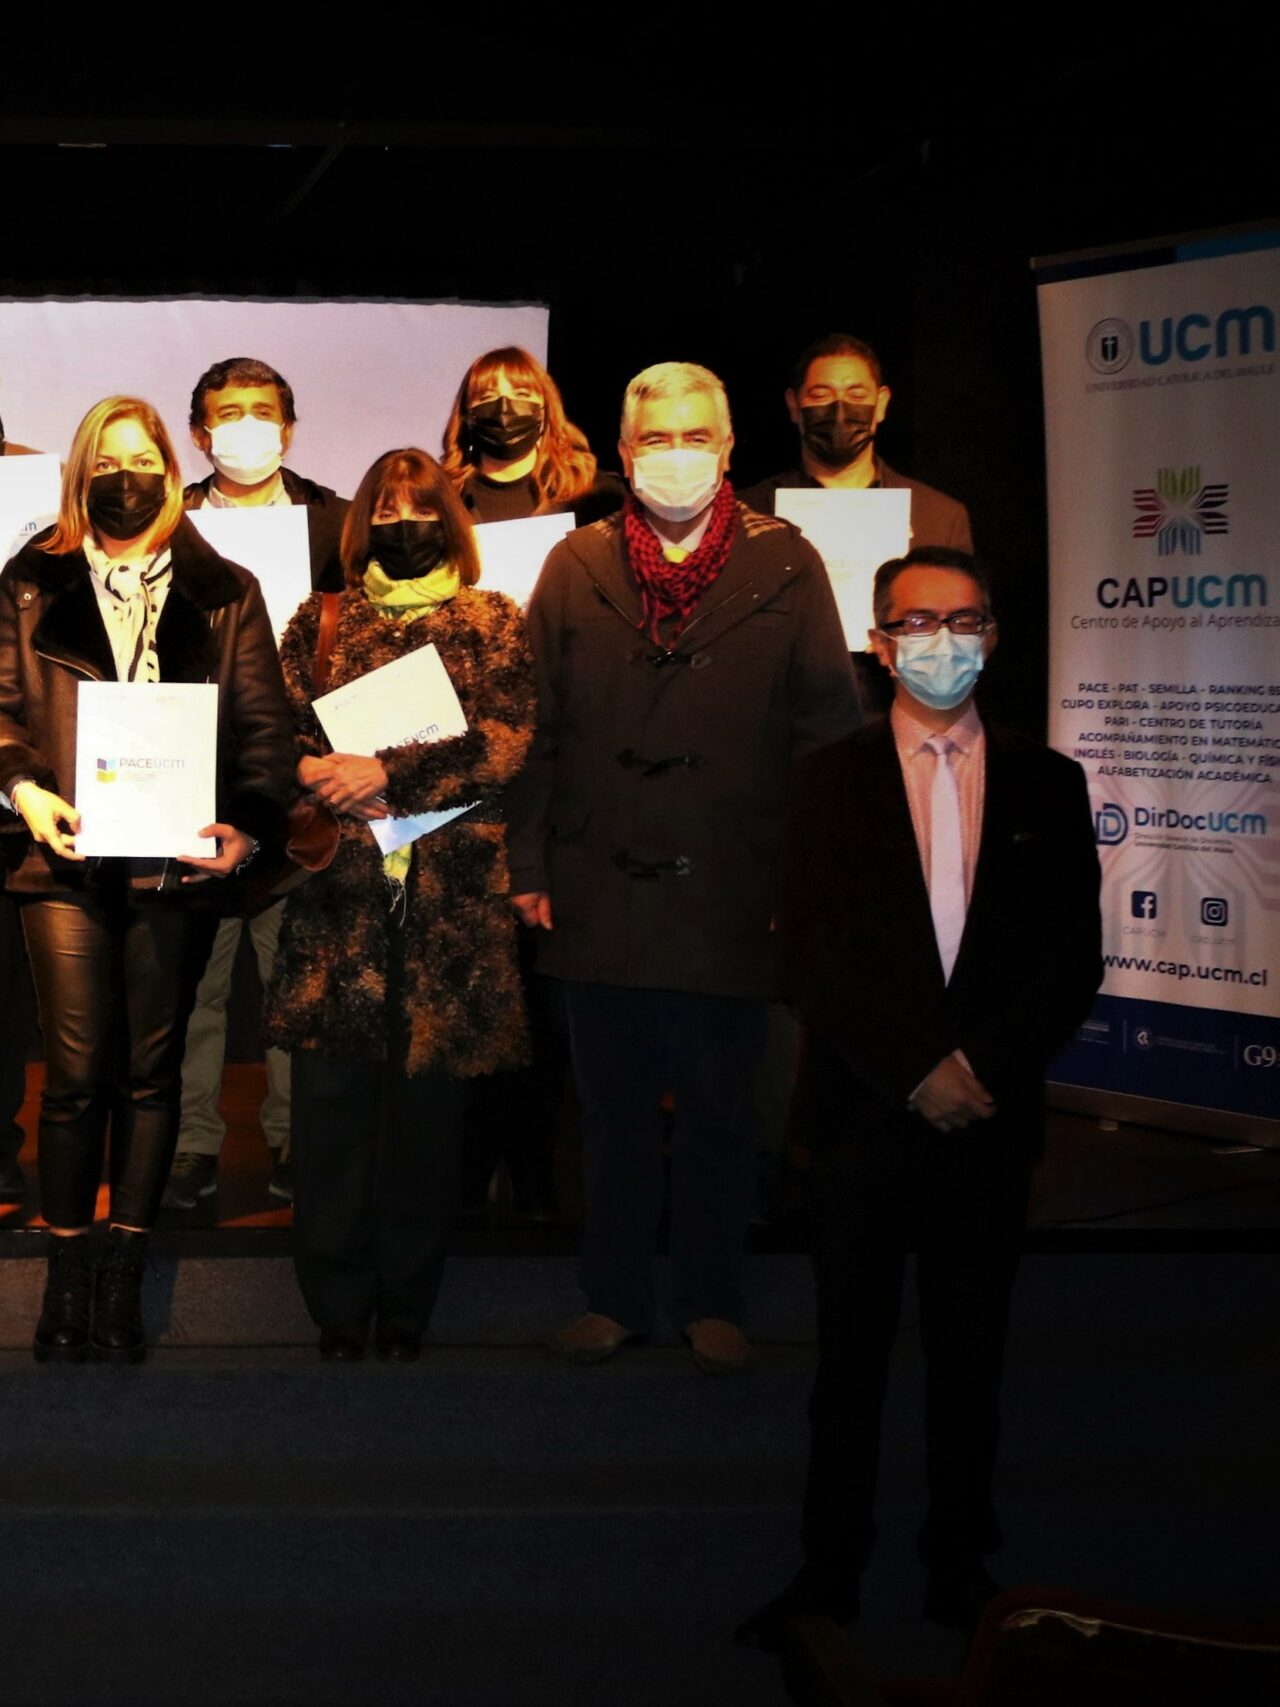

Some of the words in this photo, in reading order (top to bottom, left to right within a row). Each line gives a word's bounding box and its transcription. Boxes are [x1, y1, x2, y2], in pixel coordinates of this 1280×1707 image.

[1071, 615, 1118, 629] Centro
[1122, 615, 1138, 628] de
[1142, 614, 1184, 632] Apoyo
[1191, 615, 1203, 628] al
[1078, 683, 1109, 693] PACE
[1119, 684, 1138, 693] PAT
[1149, 684, 1197, 694] SEMILLA
[1209, 685, 1264, 695] RANKING
[1061, 699, 1094, 709] CUPO
[1098, 700, 1149, 710] EXPLORA
[1160, 701, 1200, 711] APOYO
[1105, 717, 1129, 726] PARI
[1139, 718, 1185, 728] CENTRO
[1190, 719, 1205, 729] DE
[1210, 717, 1263, 730] TUTORÍA
[1078, 732, 1187, 746] ACOMPAÑAMIENTO
[1192, 736, 1208, 746] EN
[1074, 748, 1115, 759] INGLÉS
[1124, 749, 1178, 761] BIOLOGÍA
[1189, 752, 1244, 765] QUÍMICA
[1247, 755, 1255, 764] Y
[1098, 765, 1193, 779] ALFABETIZACIÓN
[1197, 769, 1272, 783] ACADÉMICA
[1102, 955, 1268, 986] www.cap.ucm.cl
[1243, 1044, 1276, 1068] G9
